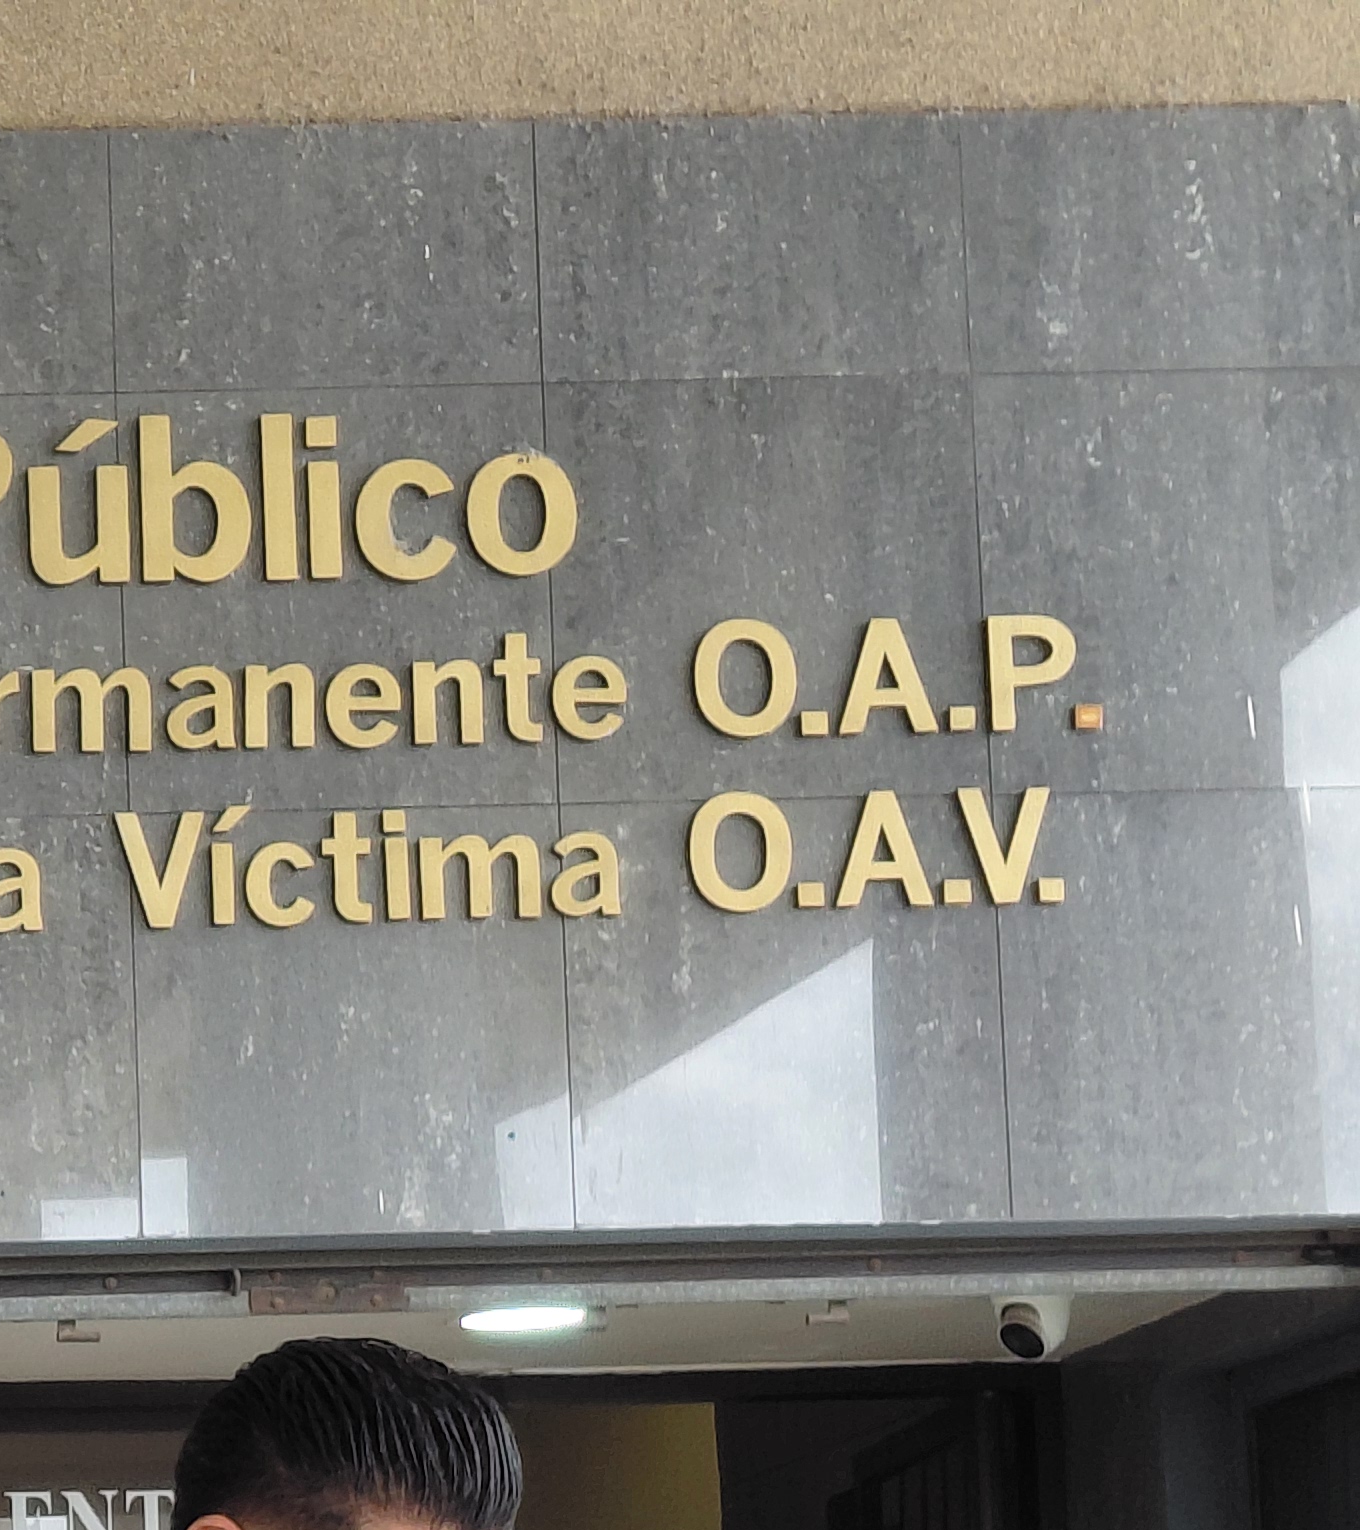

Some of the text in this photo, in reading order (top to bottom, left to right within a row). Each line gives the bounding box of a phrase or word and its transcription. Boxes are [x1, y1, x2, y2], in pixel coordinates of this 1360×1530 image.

[693, 614, 1103, 740] O.A.P.
[113, 803, 622, 930] Víctima
[688, 787, 1065, 914] O.A.V.
